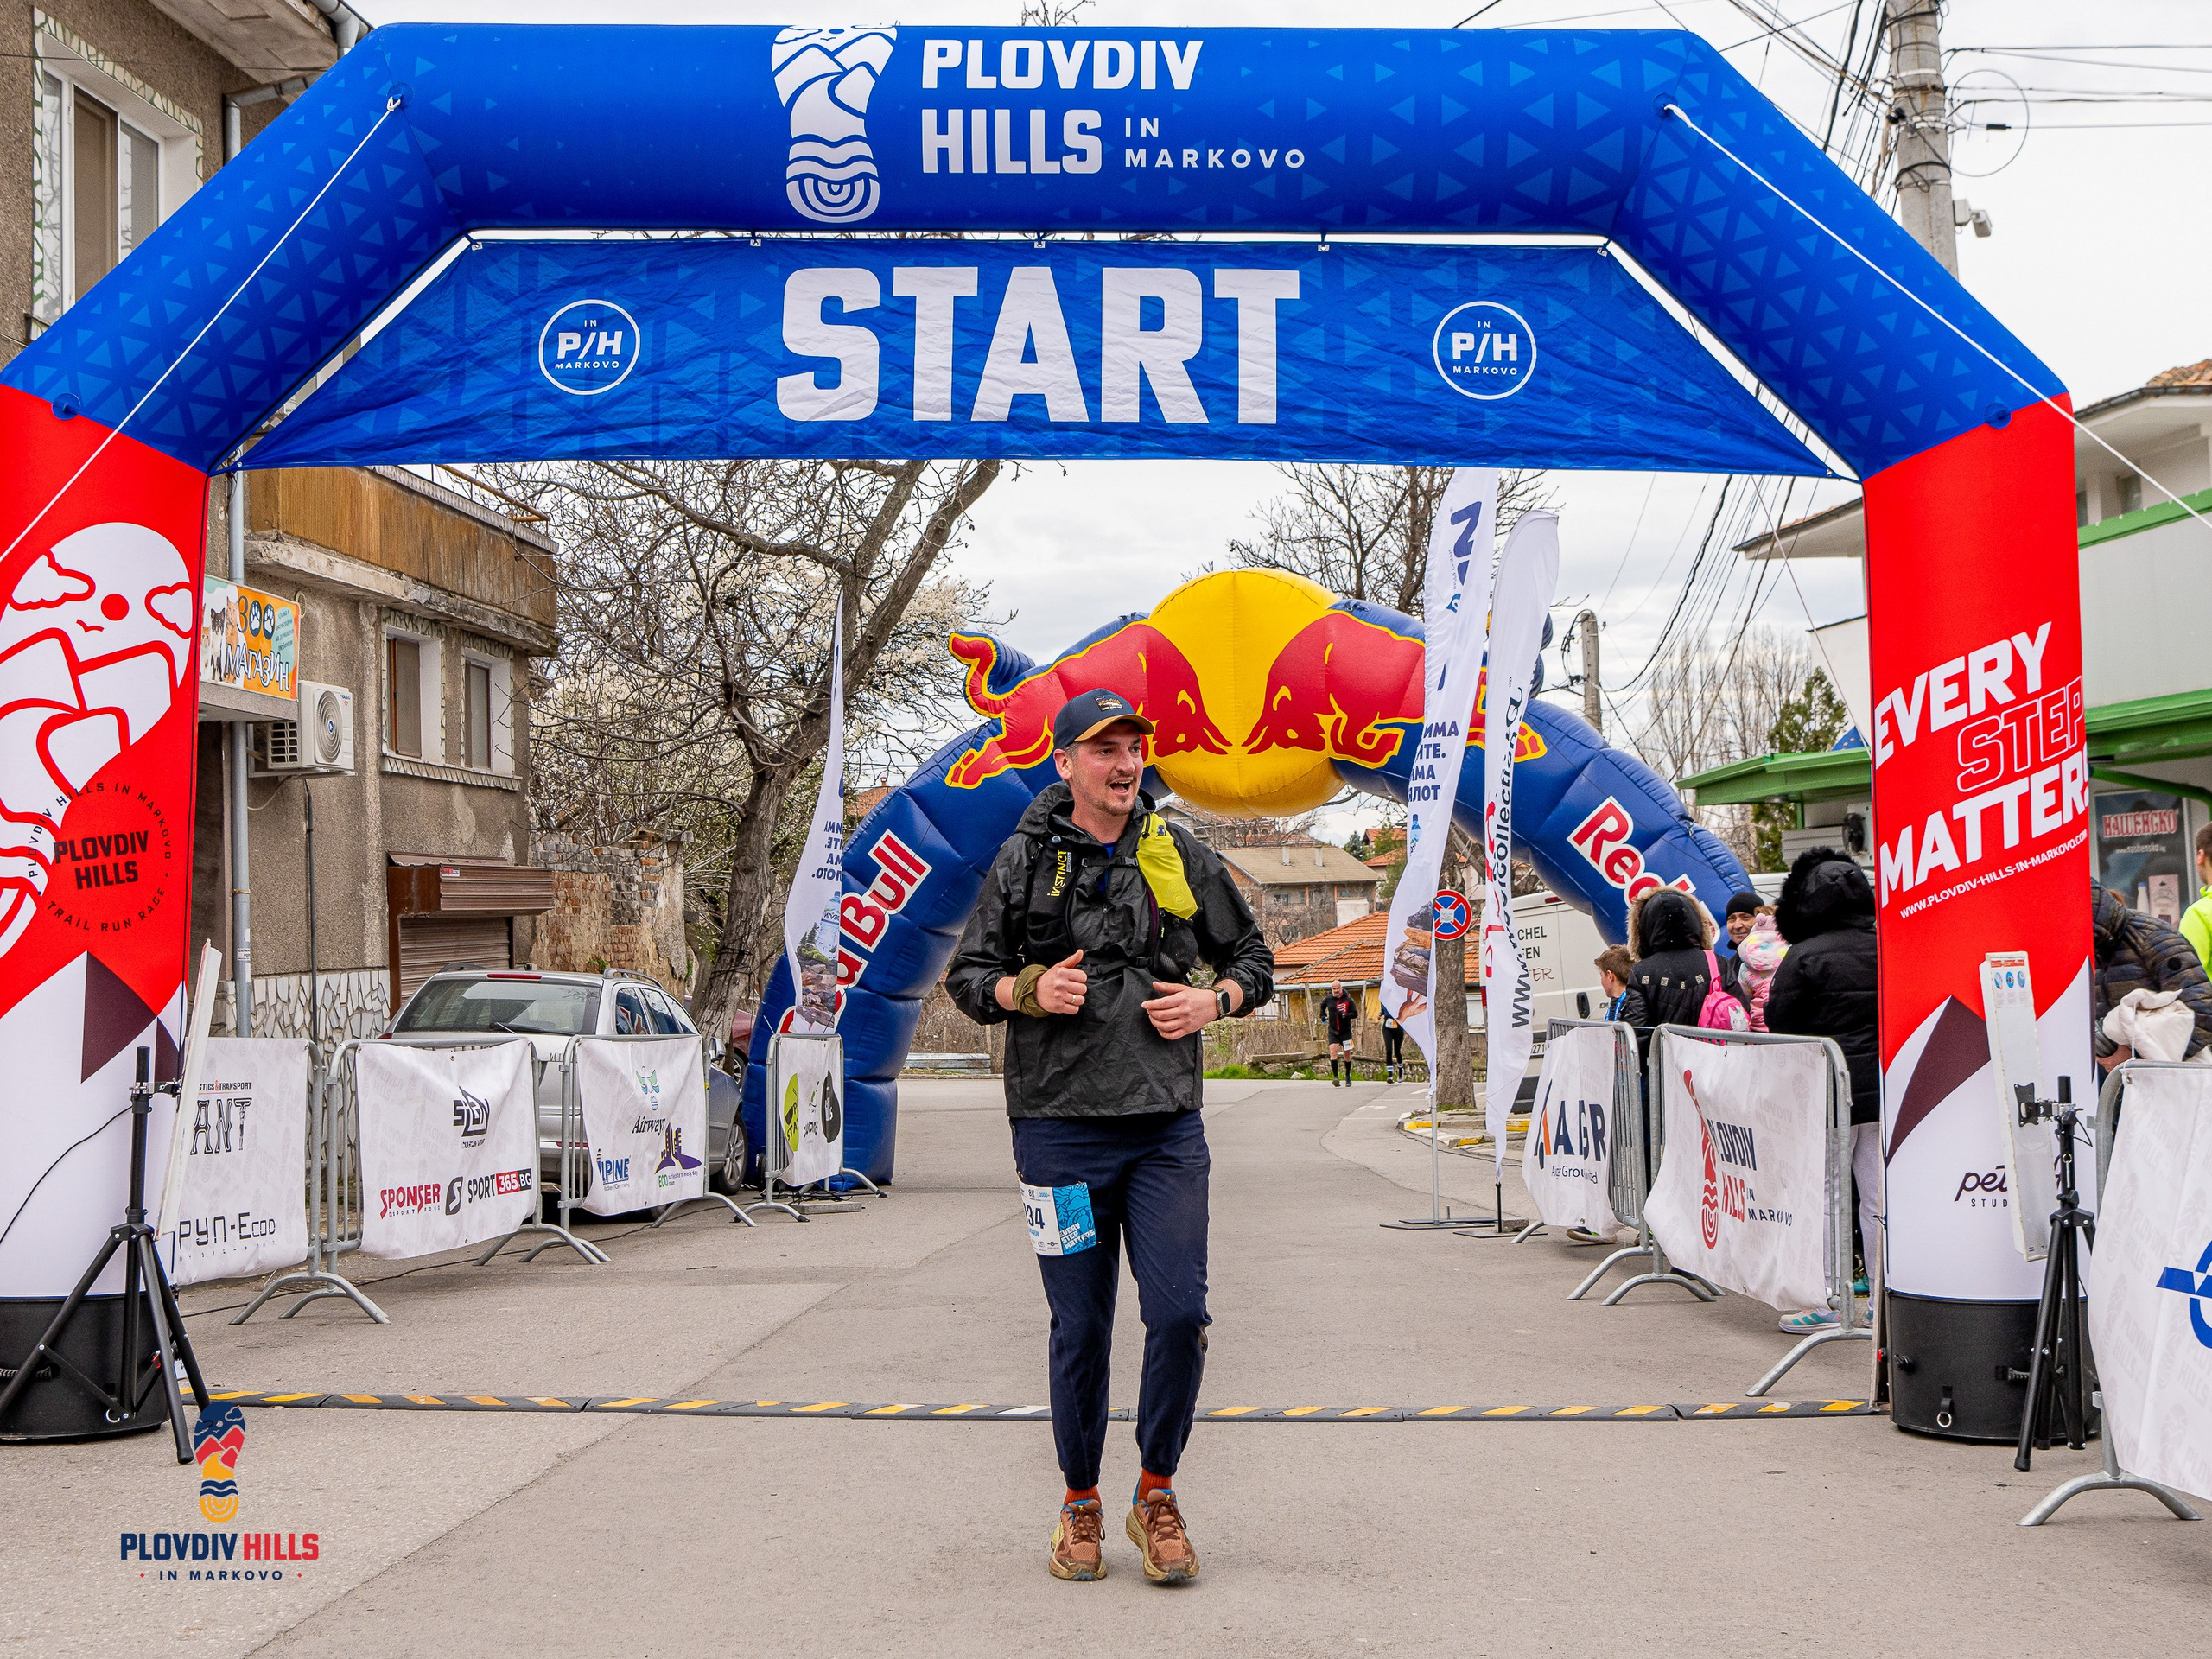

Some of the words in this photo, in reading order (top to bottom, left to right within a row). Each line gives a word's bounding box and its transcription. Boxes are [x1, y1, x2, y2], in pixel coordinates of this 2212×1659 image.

[922, 39, 1204, 90] PLOVDIV
[921, 109, 1102, 174] HILLS
[1124, 118, 1160, 137] IN
[1124, 149, 1306, 169] MARKOVO
[557, 331, 623, 359] P/H
[776, 266, 1300, 424] START
[1452, 332, 1517, 363] P/H
[555, 360, 620, 370] MARKOVO
[1453, 365, 1517, 375] MARKOVO
[226, 643, 289, 691] МАГАЗИН
[1874, 621, 2052, 770] EVERY
[1957, 676, 2085, 792] STEP
[28, 809, 54, 877] PLOVDIV
[56, 783, 104, 806] HILLS
[115, 783, 130, 794] IN
[137, 792, 171, 859] MARKOVO
[2102, 809, 2178, 839] НАШЕНСКО
[53, 830, 149, 864] PLOVDIV
[75, 861, 139, 889] HILLS
[840, 832, 926, 948] Bull
[1900, 829, 2088, 918] WWW.PLOVDIV-HILLS-IN-MARKOVO.COM
[48, 900, 90, 931] TRAIL
[101, 918, 132, 932] RUN
[138, 887, 165, 921] RACE
[219, 1082, 251, 1090] TRANSPORT
[380, 1183, 441, 1219] SPONSER
[1721, 1170, 1745, 1223] HILLS
[1747, 1187, 1756, 1201] IN
